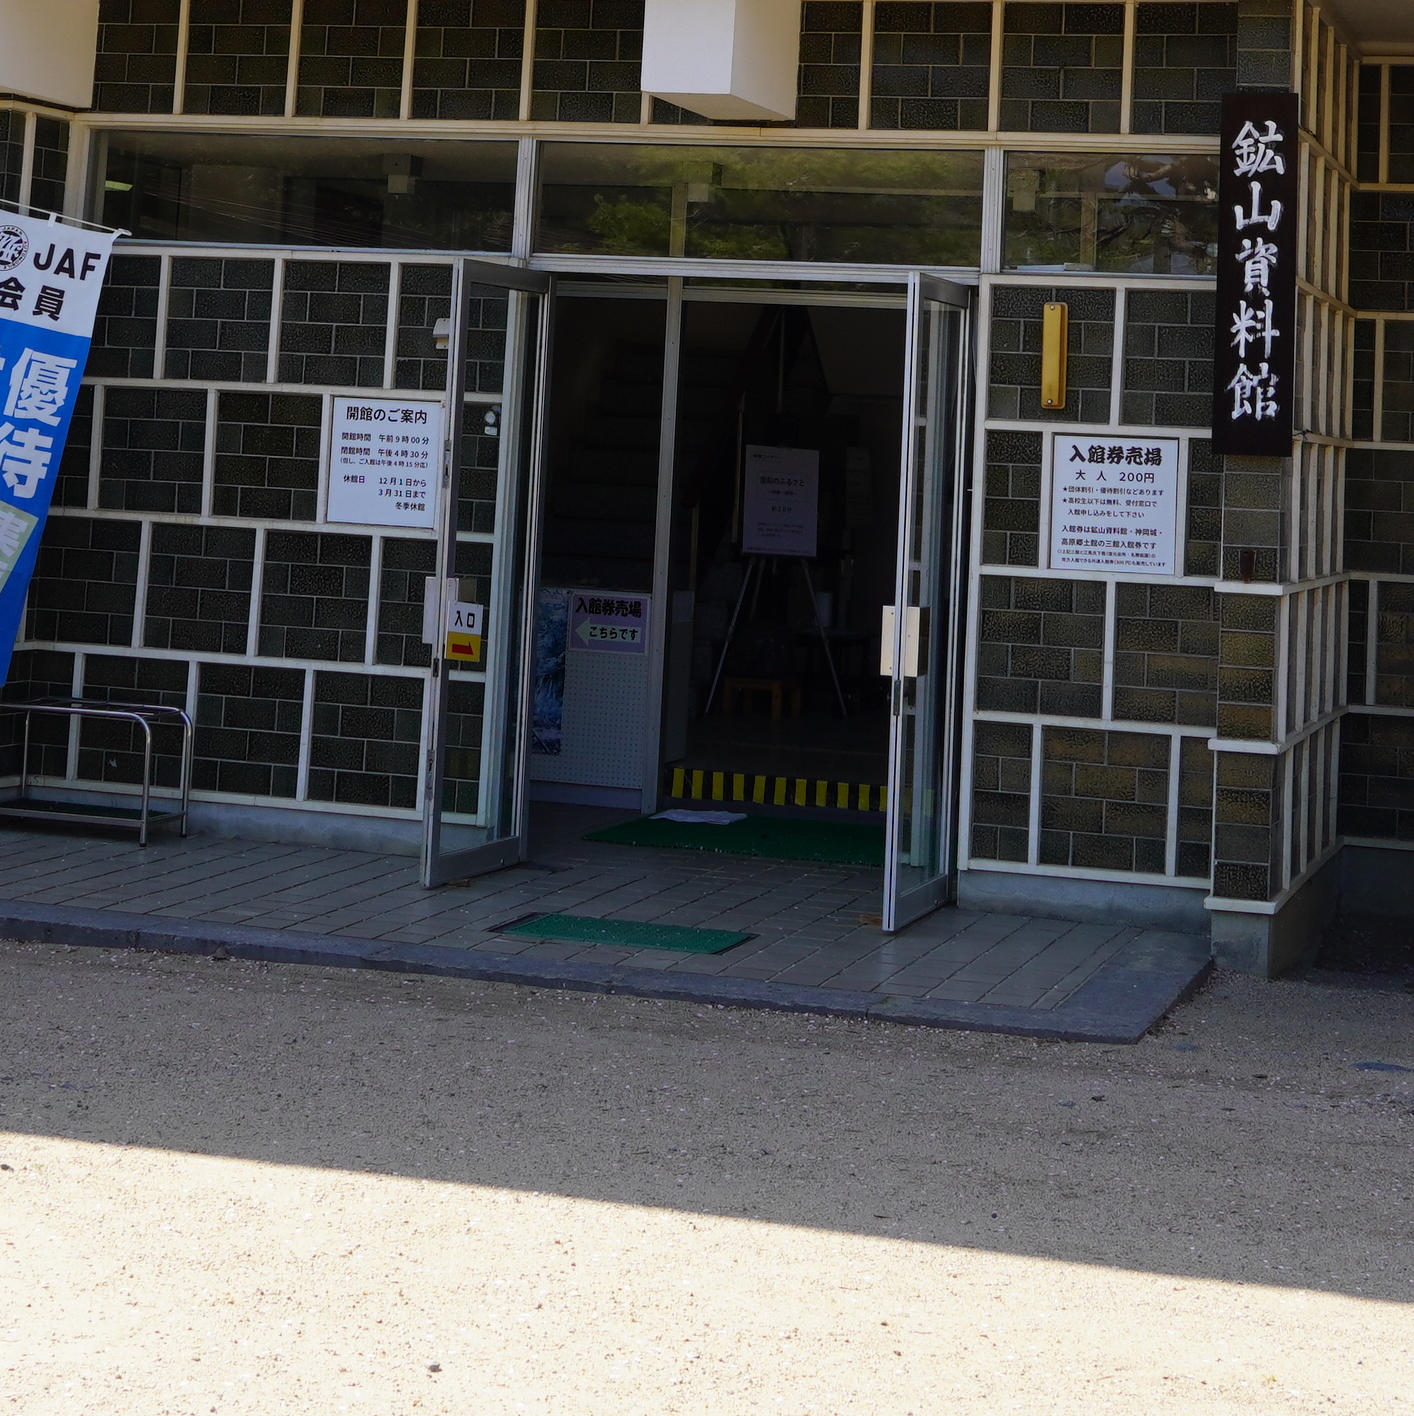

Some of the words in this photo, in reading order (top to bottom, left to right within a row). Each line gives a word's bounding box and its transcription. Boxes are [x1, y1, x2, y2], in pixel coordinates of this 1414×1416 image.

[33, 244, 101, 281] JAF
[1225, 120, 1286, 422] 鉱山資料館
[346, 406, 427, 424] 開館のご案内
[342, 432, 371, 442] 開館時間
[1069, 444, 1163, 466] 入館券売場
[344, 475, 365, 484] 休館日
[1119, 472, 1155, 483] 200円
[395, 502, 425, 511] 冬季休館
[575, 597, 643, 618] 入館券売場
[454, 610, 475, 628] 入口
[589, 626, 639, 641] こちらです
